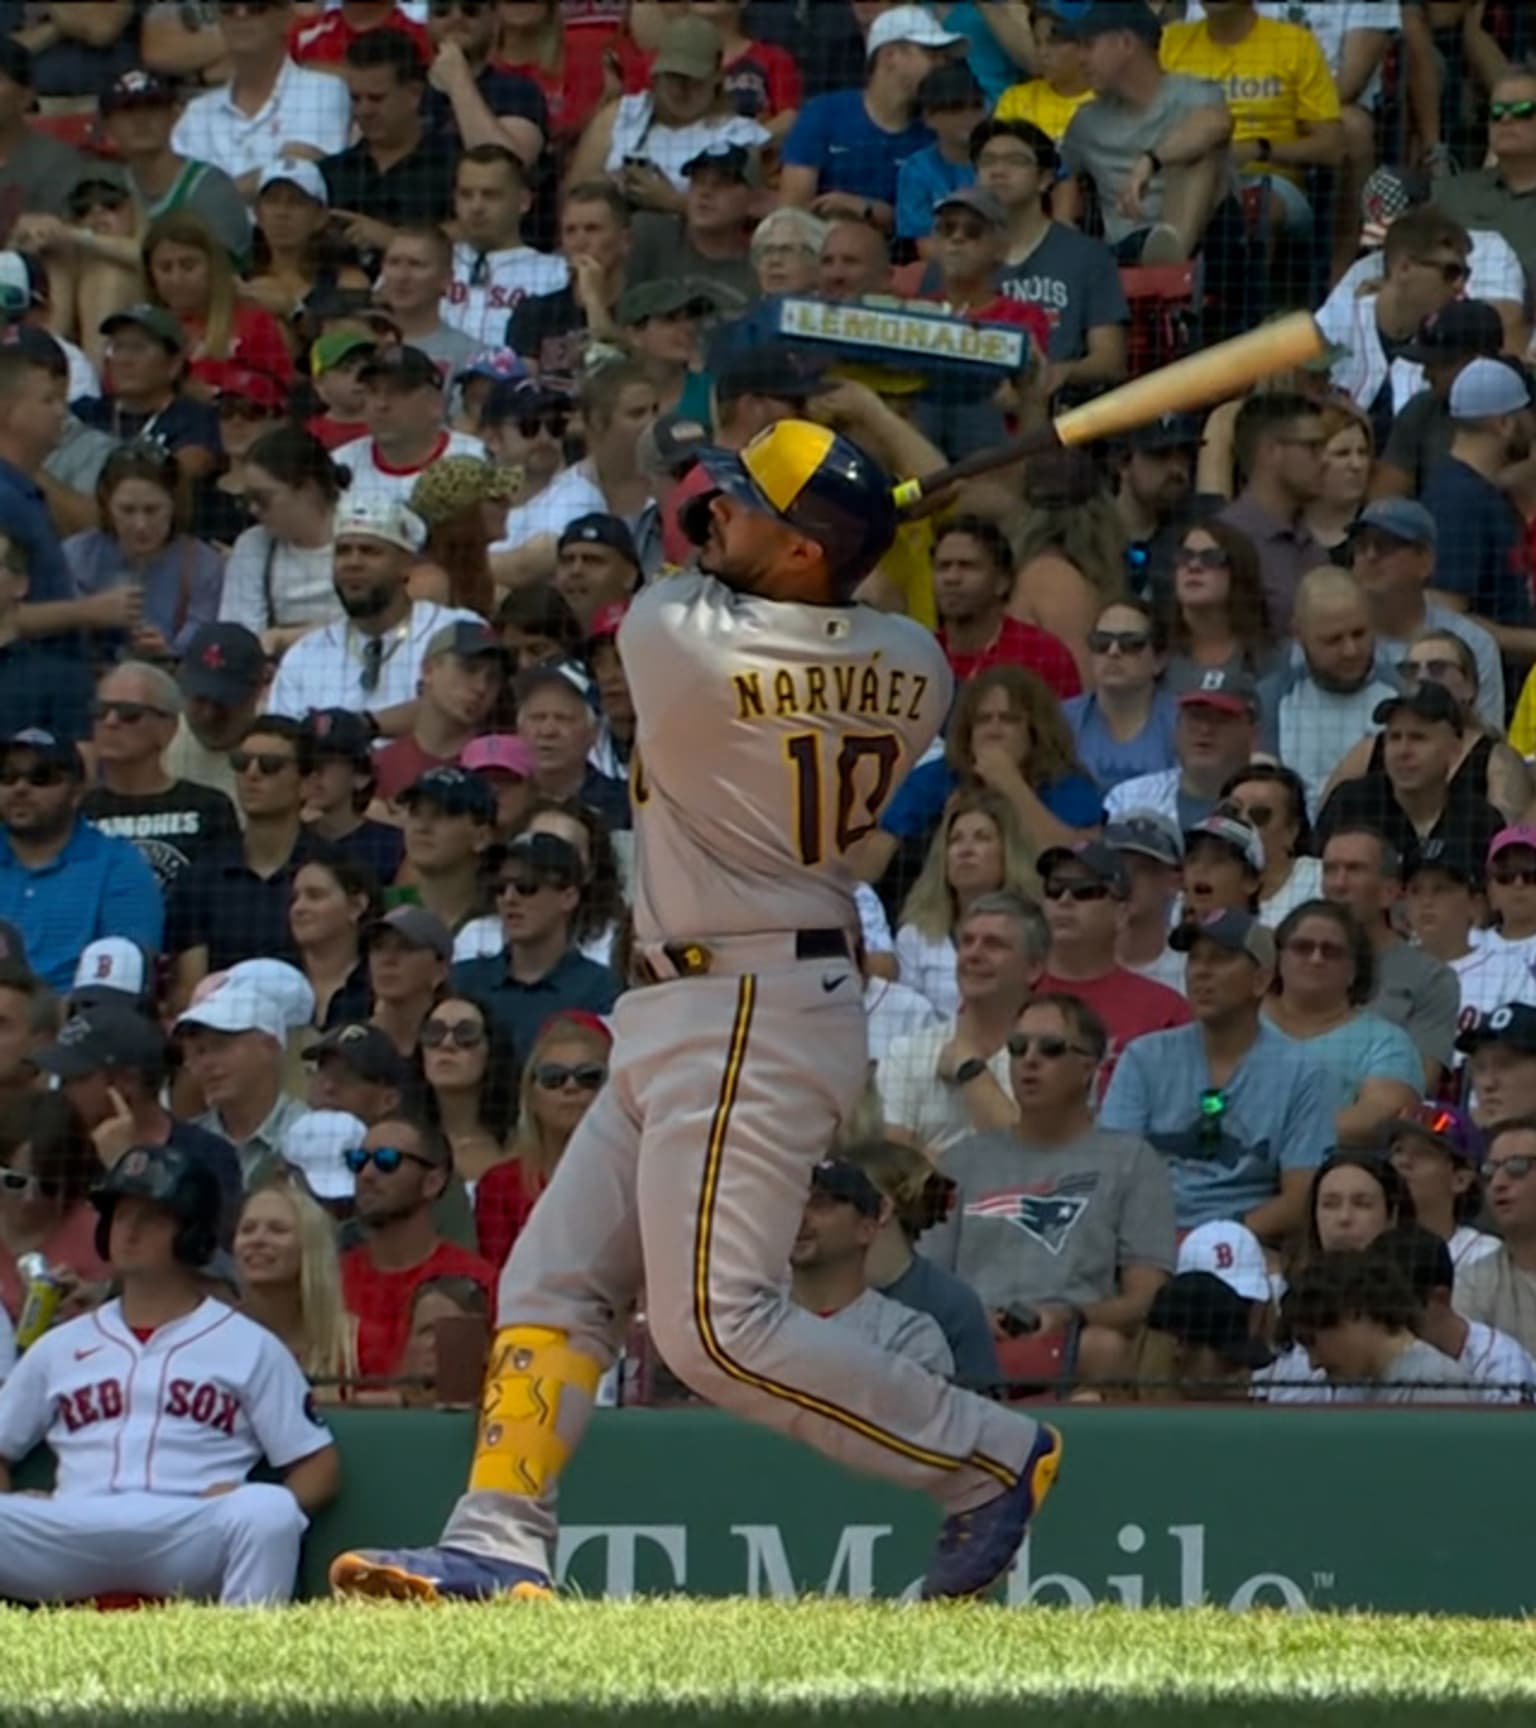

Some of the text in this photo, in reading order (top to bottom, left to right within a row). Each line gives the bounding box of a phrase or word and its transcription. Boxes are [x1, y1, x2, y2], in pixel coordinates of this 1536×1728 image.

[1224, 73, 1283, 100] ton
[800, 308, 1007, 360] LEMONADE
[734, 653, 929, 721] NARVÁEZ
[786, 732, 903, 865] 10
[85, 812, 199, 838] AMONES
[1213, 1242, 1234, 1270] B
[60, 1378, 241, 1438] RED SOX
